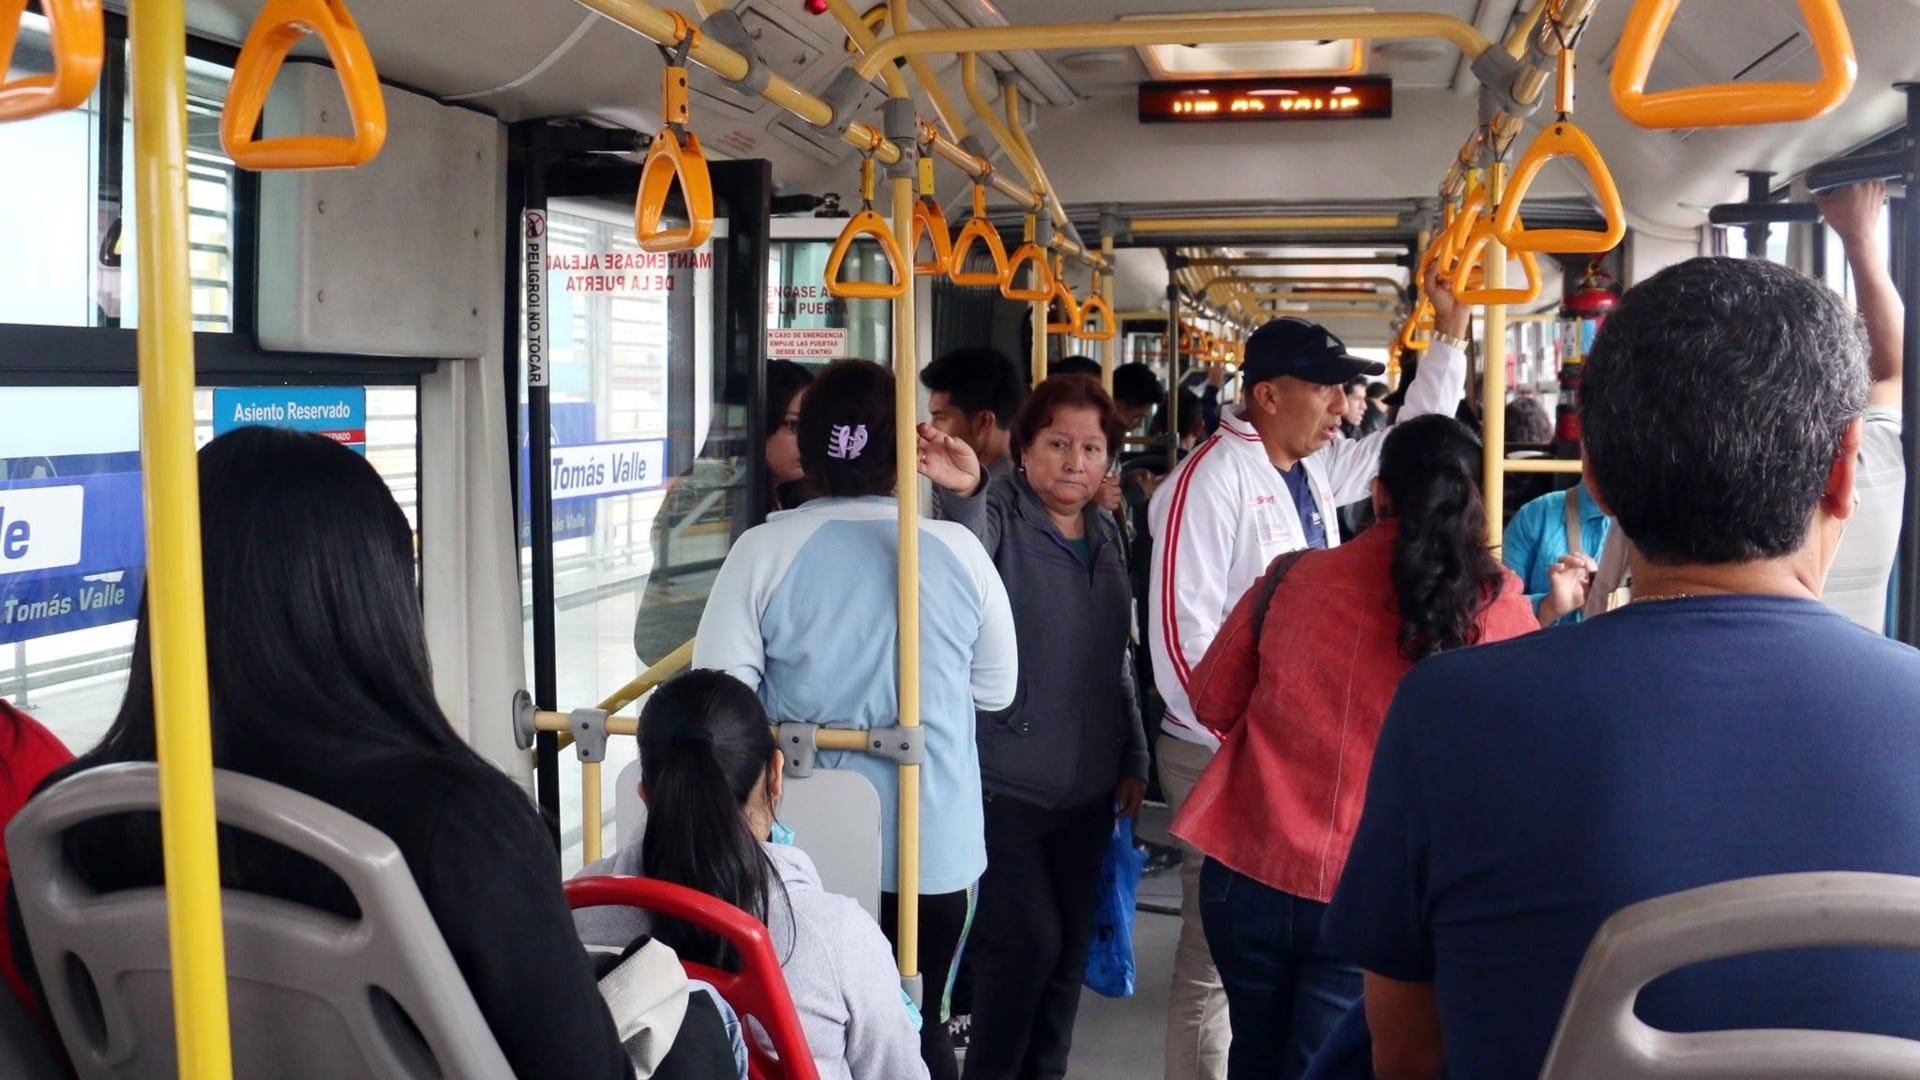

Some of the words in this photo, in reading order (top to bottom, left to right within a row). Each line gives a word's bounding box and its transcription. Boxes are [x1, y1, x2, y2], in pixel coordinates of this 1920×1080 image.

[527, 243, 540, 307] PELIGRO!
[528, 312, 541, 332] NO
[779, 302, 795, 314] LA
[799, 302, 849, 314] PUERTA
[528, 336, 542, 383] TOCAR
[234, 403, 284, 422] Asiento
[287, 401, 351, 420] Reservado
[552, 456, 605, 490] Tomás
[612, 451, 647, 484] Valle
[4, 592, 72, 624] Tomás
[79, 583, 126, 612] Valle
